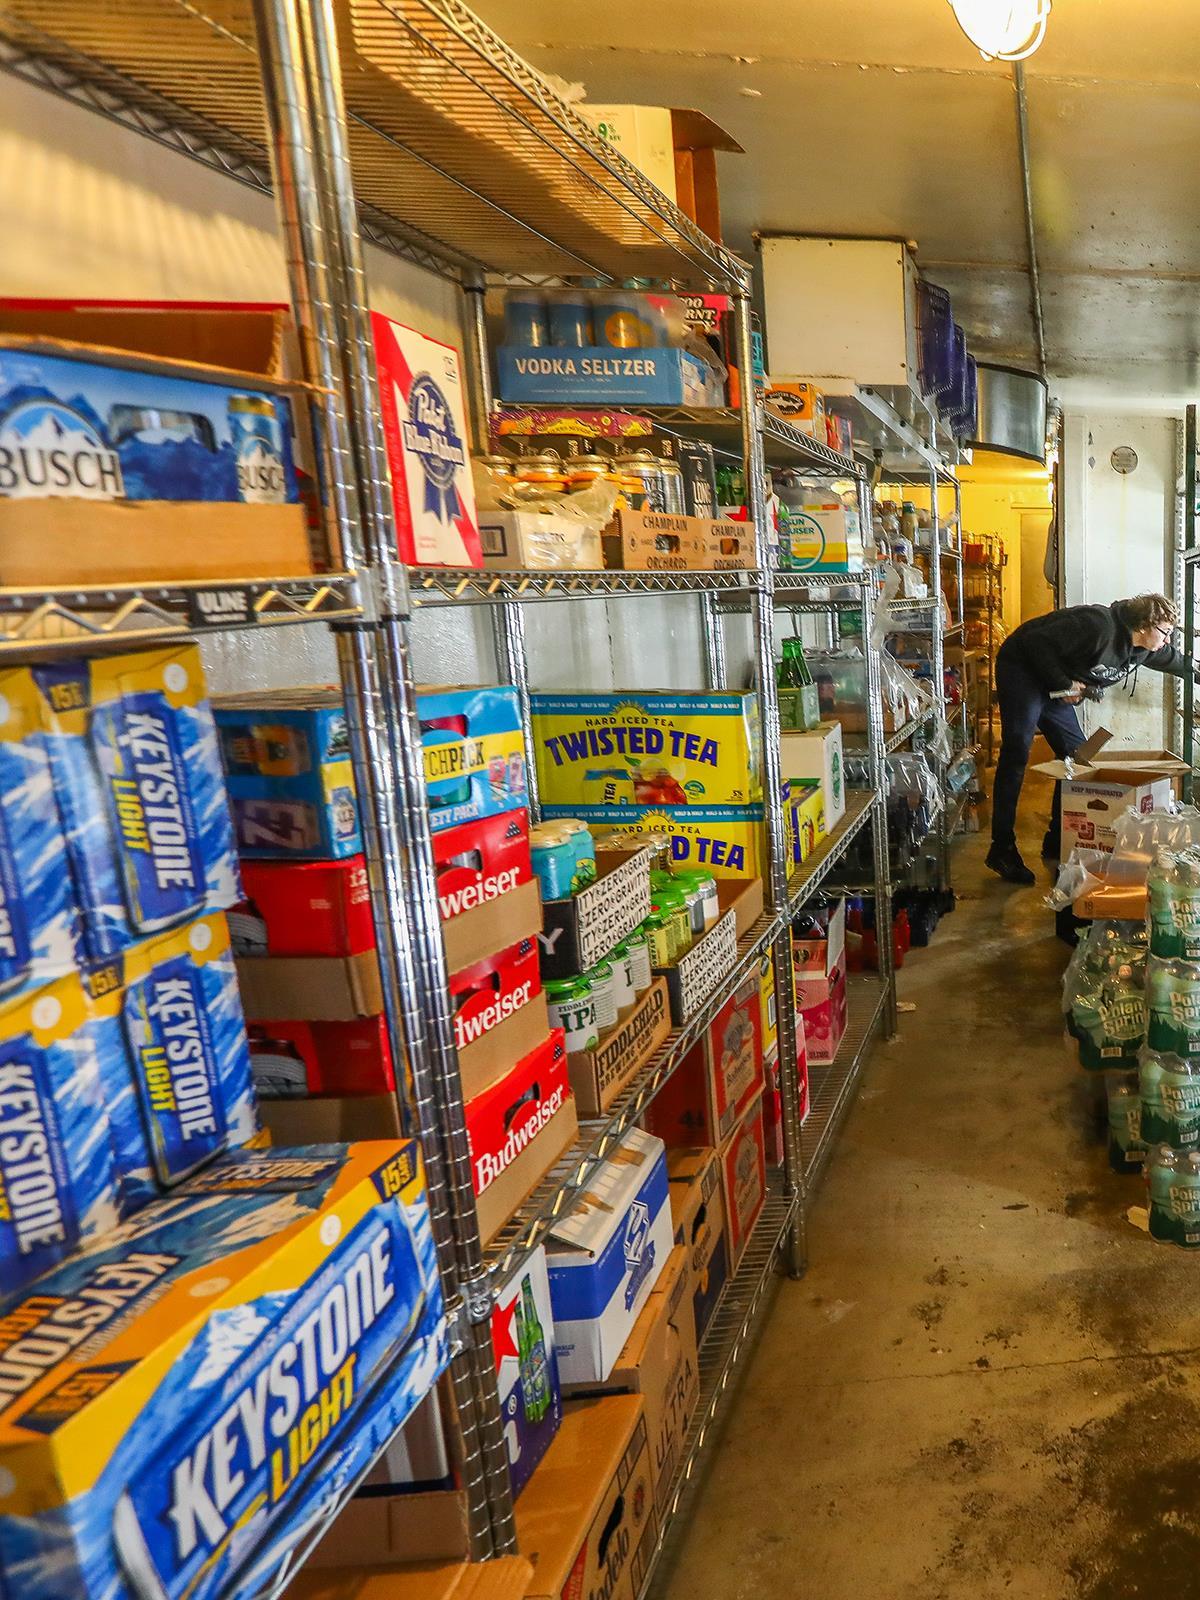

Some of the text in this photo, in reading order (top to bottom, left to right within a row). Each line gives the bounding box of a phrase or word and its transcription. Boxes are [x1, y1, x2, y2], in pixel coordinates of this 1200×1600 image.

[514, 357, 656, 377] VODKA SELTZER
[642, 515, 688, 531] CHAMPLAIN
[711, 525, 746, 538] CHAMPLAIN
[646, 557, 688, 569] ORCHARDS
[585, 716, 674, 728] HARD ICED TEA
[543, 726, 719, 768] TWISTED TEA
[112, 778, 152, 853] LIGHT
[125, 712, 196, 891] KEYSTONE
[648, 825, 701, 835] ICED TEA
[695, 837, 745, 872] TEA
[440, 865, 520, 919] weiser
[600, 870, 625, 892] ZERO
[455, 980, 532, 1050] dweiser
[559, 1006, 597, 1034] IPA
[1098, 1000, 1144, 1035] Polan Sprin
[141, 1047, 178, 1112] LIGHT
[154, 977, 217, 1141] KEYSTONE
[0, 1062, 66, 1255] KEYSTONE
[475, 1083, 565, 1198] Budweiser
[380, 1161, 400, 1198] 15
[166, 1228, 395, 1560] KEYSTONE
[656, 1358, 693, 1470] ULTRA
[269, 1352, 359, 1502] LIGHT
[588, 1526, 630, 1600] odelo
